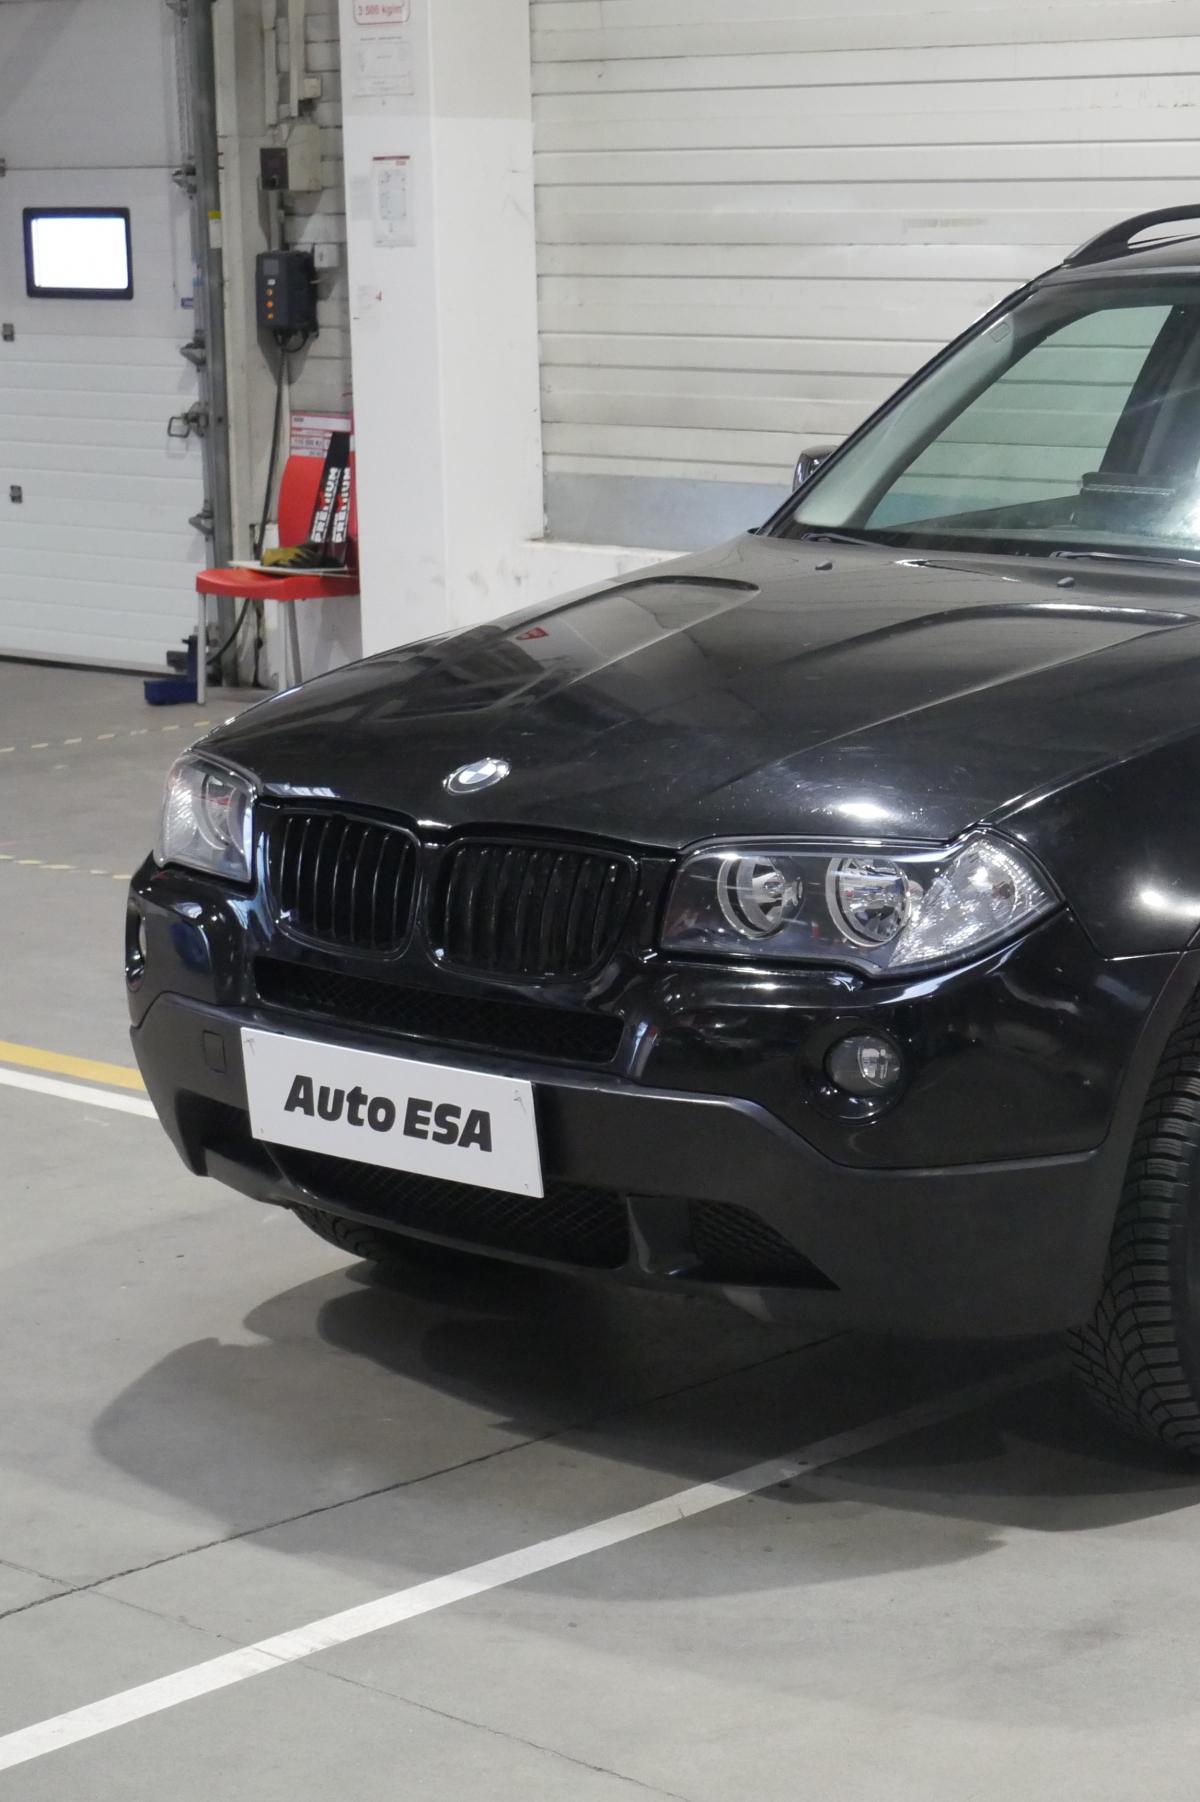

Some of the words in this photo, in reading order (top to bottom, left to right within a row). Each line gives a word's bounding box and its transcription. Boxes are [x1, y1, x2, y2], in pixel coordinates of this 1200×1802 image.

[313, 467, 338, 542] PREMIUM
[284, 1074, 396, 1133] Auto
[402, 1097, 493, 1153] ESA
